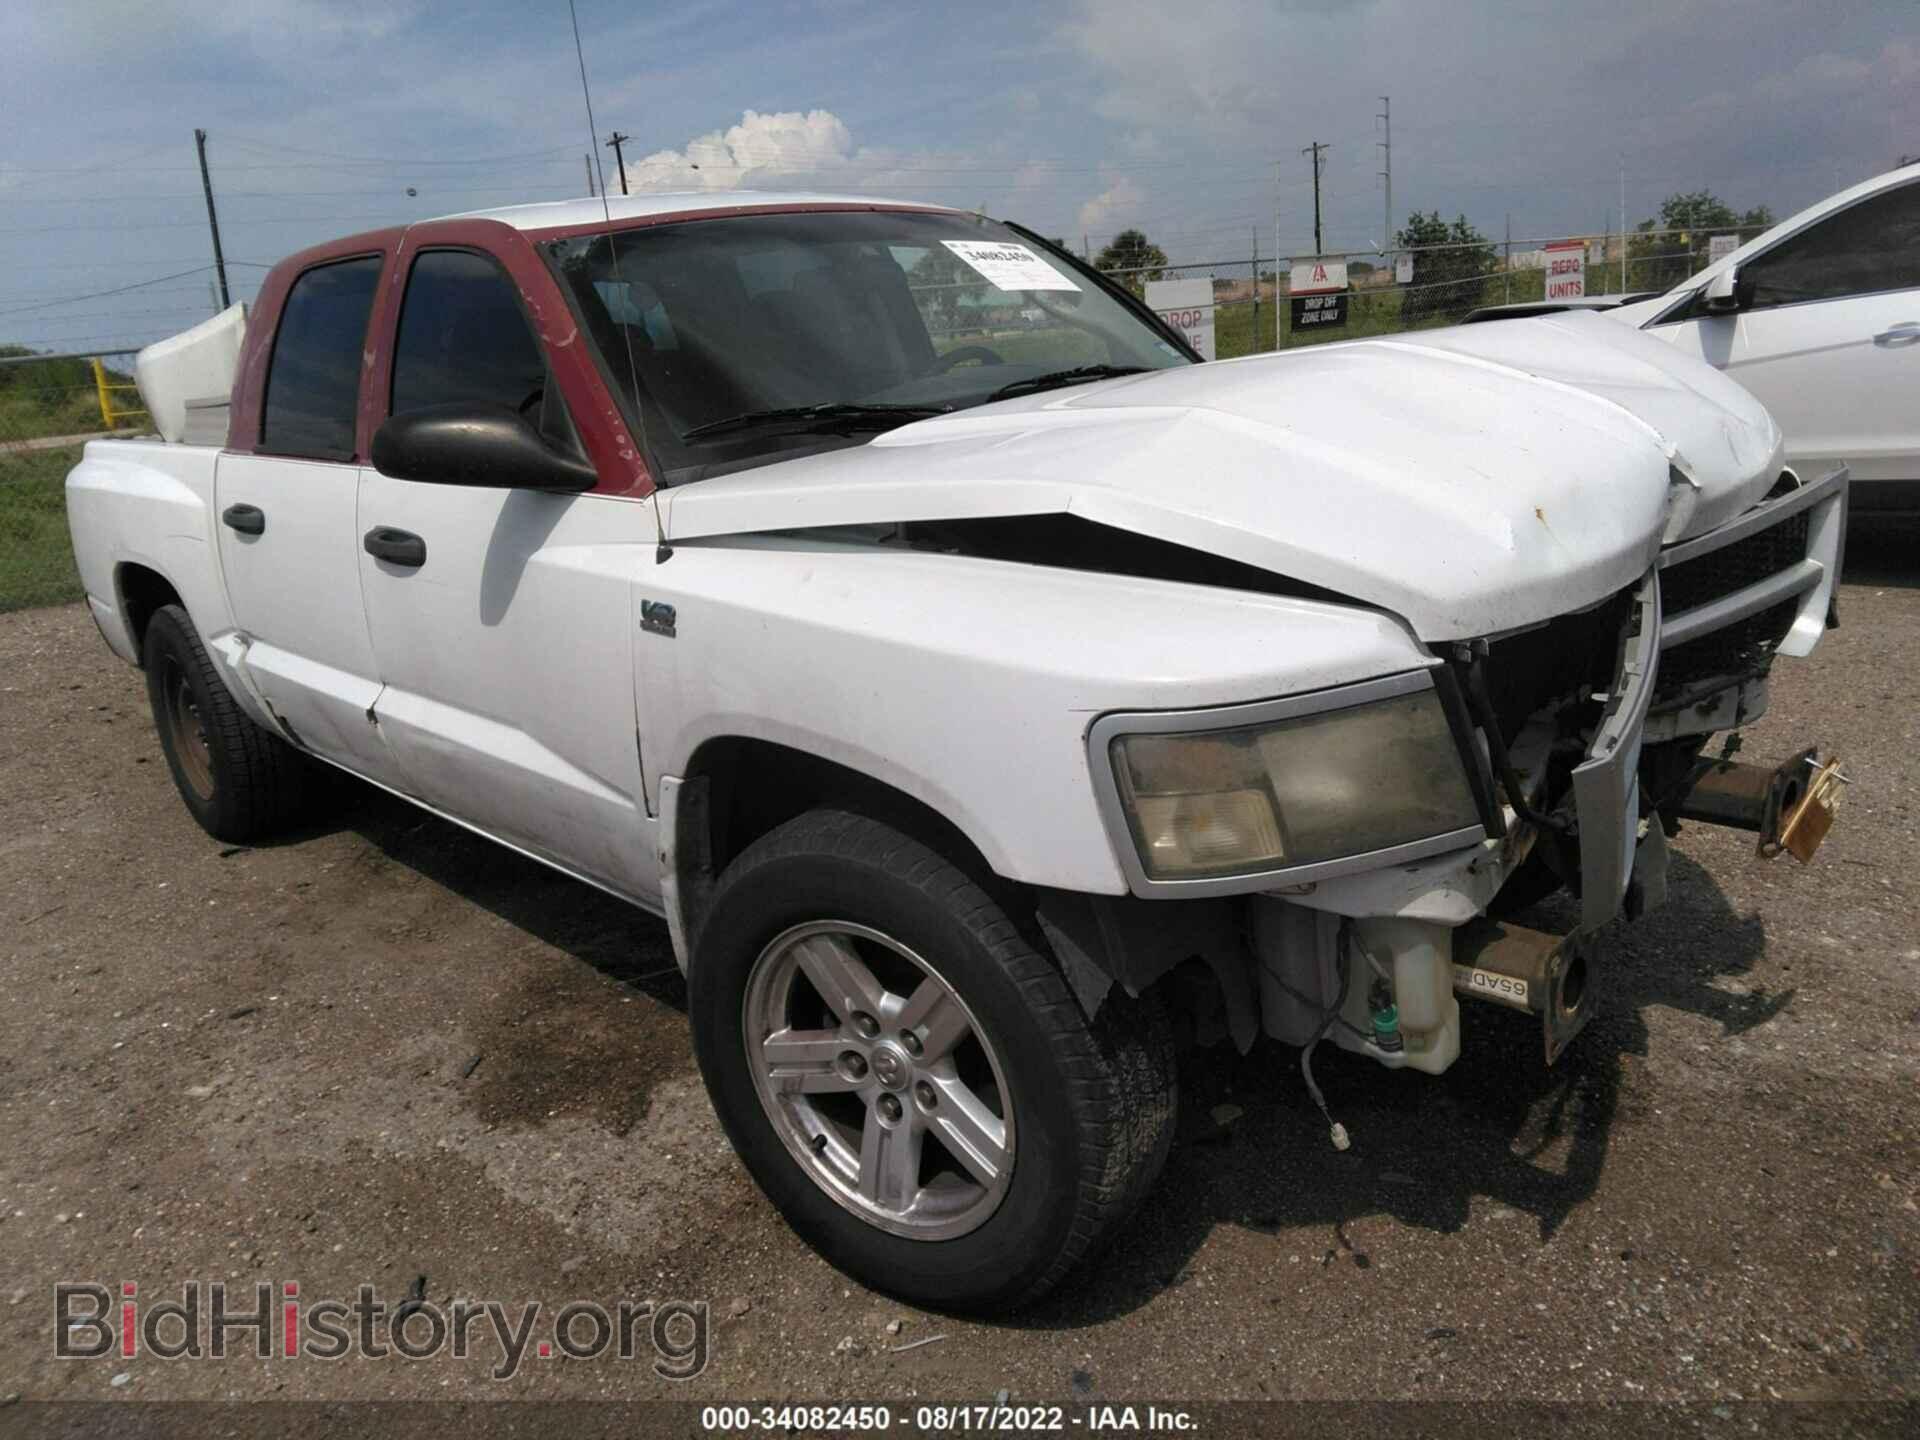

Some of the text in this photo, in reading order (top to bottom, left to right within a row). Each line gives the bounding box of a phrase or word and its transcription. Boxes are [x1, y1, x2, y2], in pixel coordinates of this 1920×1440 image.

[1551, 259, 1579, 276] REPO
[1550, 281, 1582, 298] UNITS
[1304, 298, 1323, 310] DROP
[1301, 309, 1340, 324] ZONE ONLY
[1473, 972, 1526, 996] 65AD
